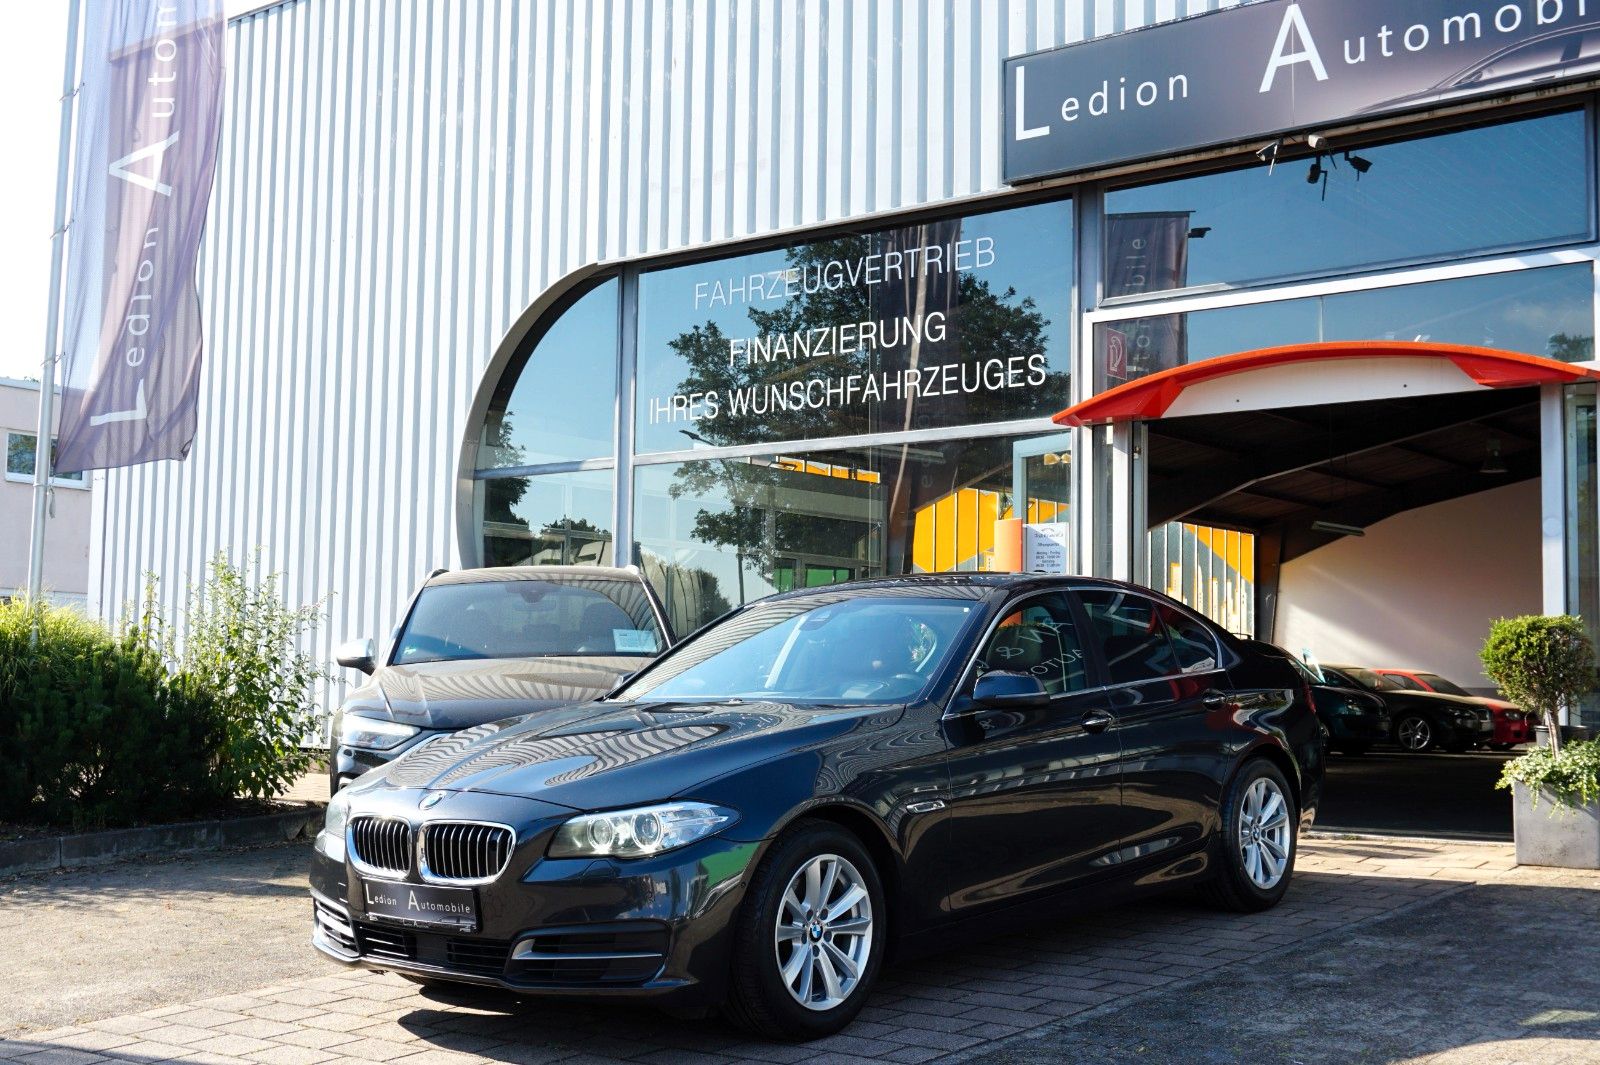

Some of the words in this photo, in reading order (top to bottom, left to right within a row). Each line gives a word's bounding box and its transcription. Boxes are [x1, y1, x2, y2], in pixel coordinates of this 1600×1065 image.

[1015, 65, 1189, 141] Ledion
[694, 237, 996, 310] FAHRZEUGVERTRIEB
[89, 225, 159, 429] Ledion
[730, 312, 946, 367] FINANZIERUNG
[649, 391, 719, 425] IHRES
[728, 354, 1047, 416] WUNSCHFAHRZEUGES
[365, 883, 398, 906] Ledion
[407, 889, 471, 914] Automobile
